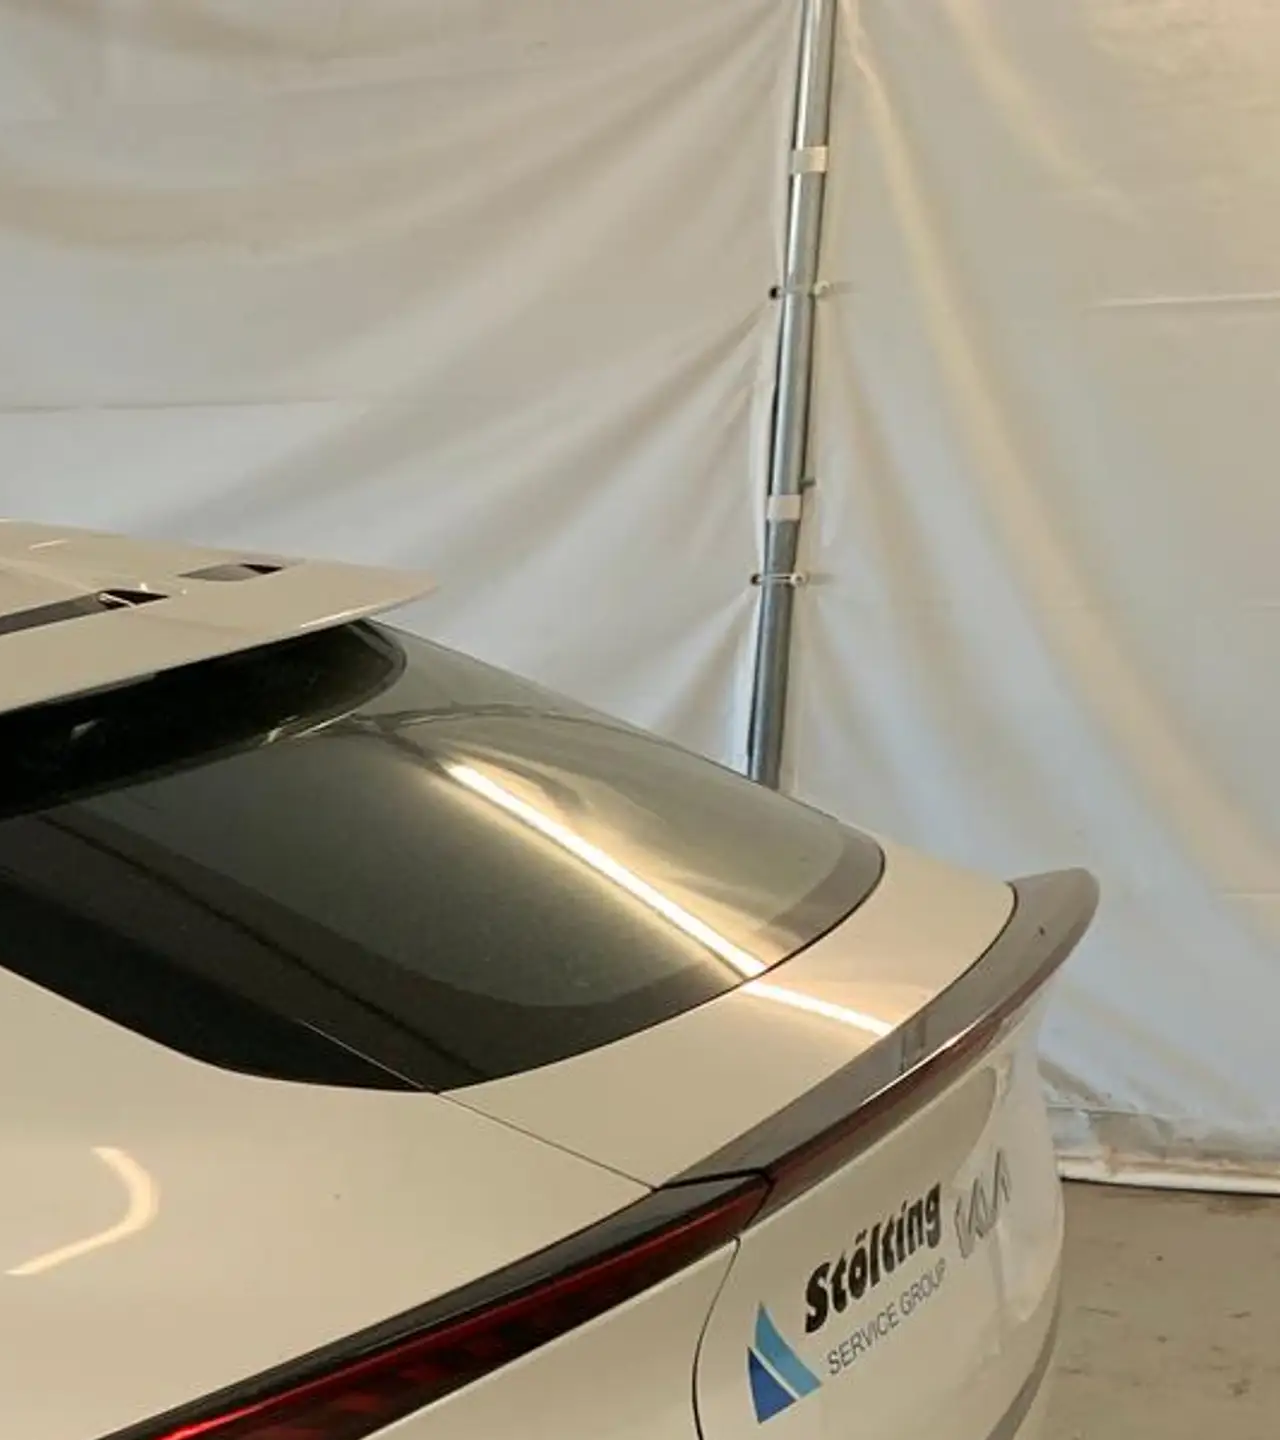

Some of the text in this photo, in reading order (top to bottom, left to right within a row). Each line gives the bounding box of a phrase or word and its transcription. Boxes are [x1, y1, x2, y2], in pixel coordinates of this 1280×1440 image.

[805, 1181, 941, 1334] Stölting
[828, 1257, 947, 1376] SERVICE GROUP
